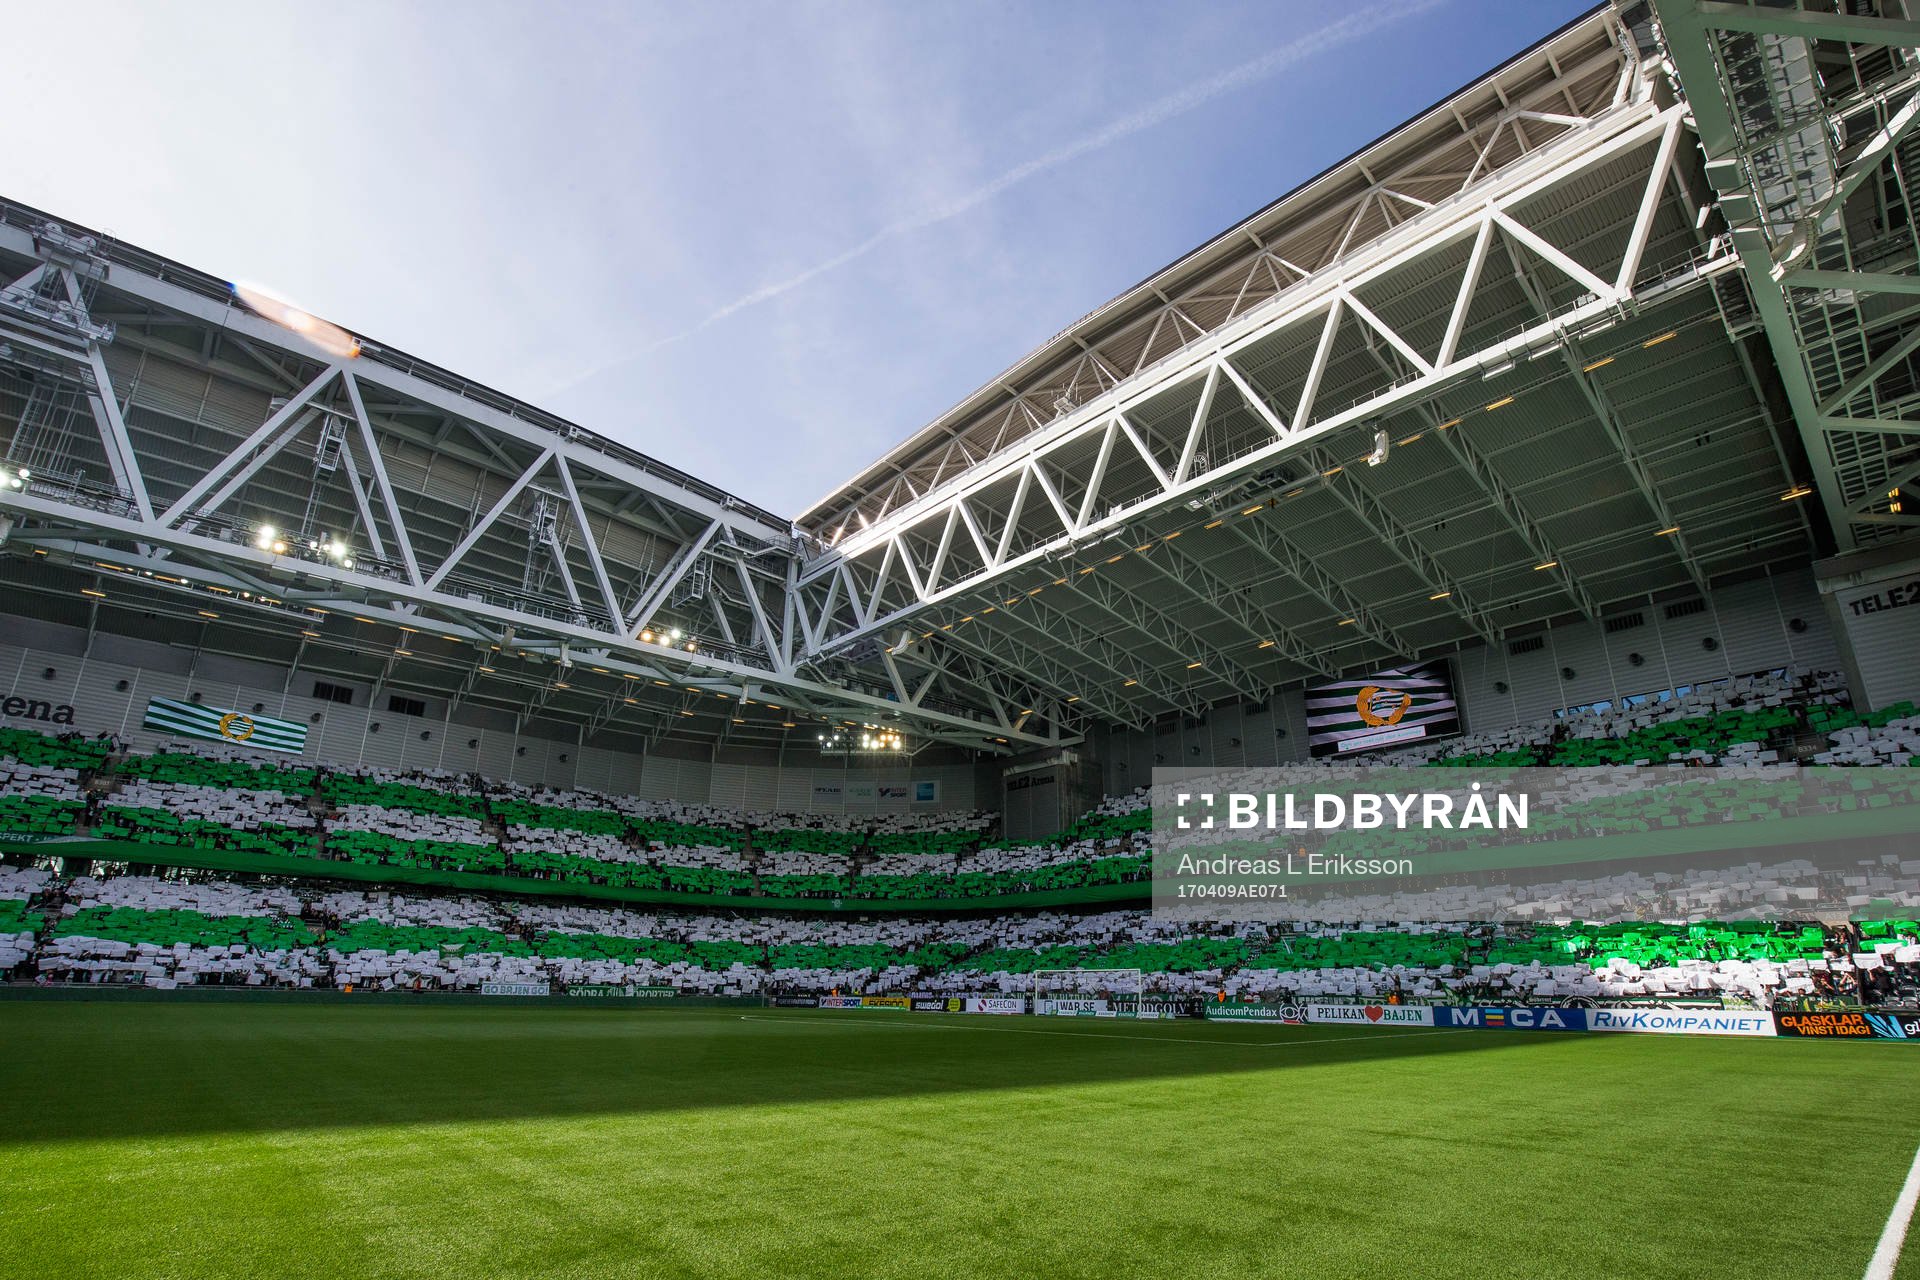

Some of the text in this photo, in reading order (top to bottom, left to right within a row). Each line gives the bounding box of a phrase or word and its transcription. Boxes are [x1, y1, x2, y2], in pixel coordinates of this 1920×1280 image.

[1849, 581, 1920, 616] TELE2
[826, 998, 861, 1007] INTERSPORT
[915, 999, 944, 1010] swedol
[1205, 1003, 1277, 1018] AudicomPendax
[1317, 1007, 1422, 1021] PELIKAN BAJEN
[1781, 1014, 1864, 1027] GLASKLAR
[1904, 1018, 1920, 1035] gl
[1797, 1025, 1834, 1035] VINST
